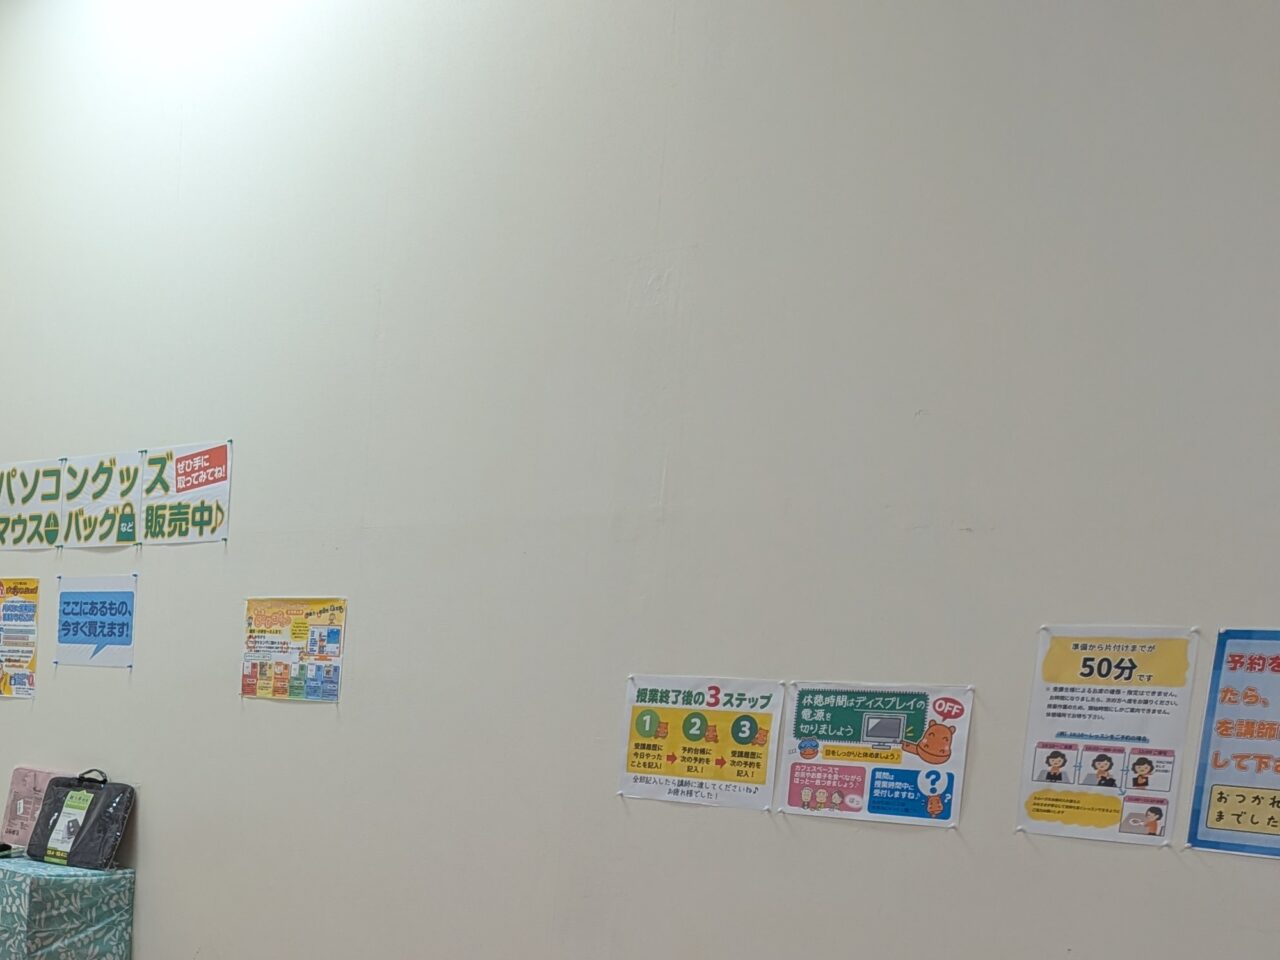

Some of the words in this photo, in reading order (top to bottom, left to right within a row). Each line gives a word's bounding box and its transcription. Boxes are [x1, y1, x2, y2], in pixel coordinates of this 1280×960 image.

[177, 456, 210, 473] ぜひ手に
[177, 466, 226, 488] 取ってみてね!
[64, 509, 118, 541] バッグ
[120, 521, 134, 532] など
[144, 500, 212, 539] 販売中
[62, 601, 131, 617] ここにあるもの、
[62, 621, 129, 637] 今すぐ買えます!
[1072, 643, 1156, 653] 準備から片付けまでが
[1080, 657, 1138, 681] 50分
[1137, 674, 1153, 682] です
[636, 685, 773, 709] 授業終了後の3ステップ
[802, 694, 926, 711] 休憩時間はディスプレイの
[1219, 686, 1269, 707] たら、
[935, 699, 961, 715] OFF
[801, 709, 832, 722] 電源を
[643, 715, 651, 731] 1
[689, 718, 701, 735] 2
[738, 721, 750, 737] 3
[800, 723, 854, 737] 切りましょう
[1216, 719, 1280, 740] を講師
[633, 752, 663, 760] 今日やった
[680, 755, 711, 764] 次の予約を
[730, 760, 762, 769] 次の予約を
